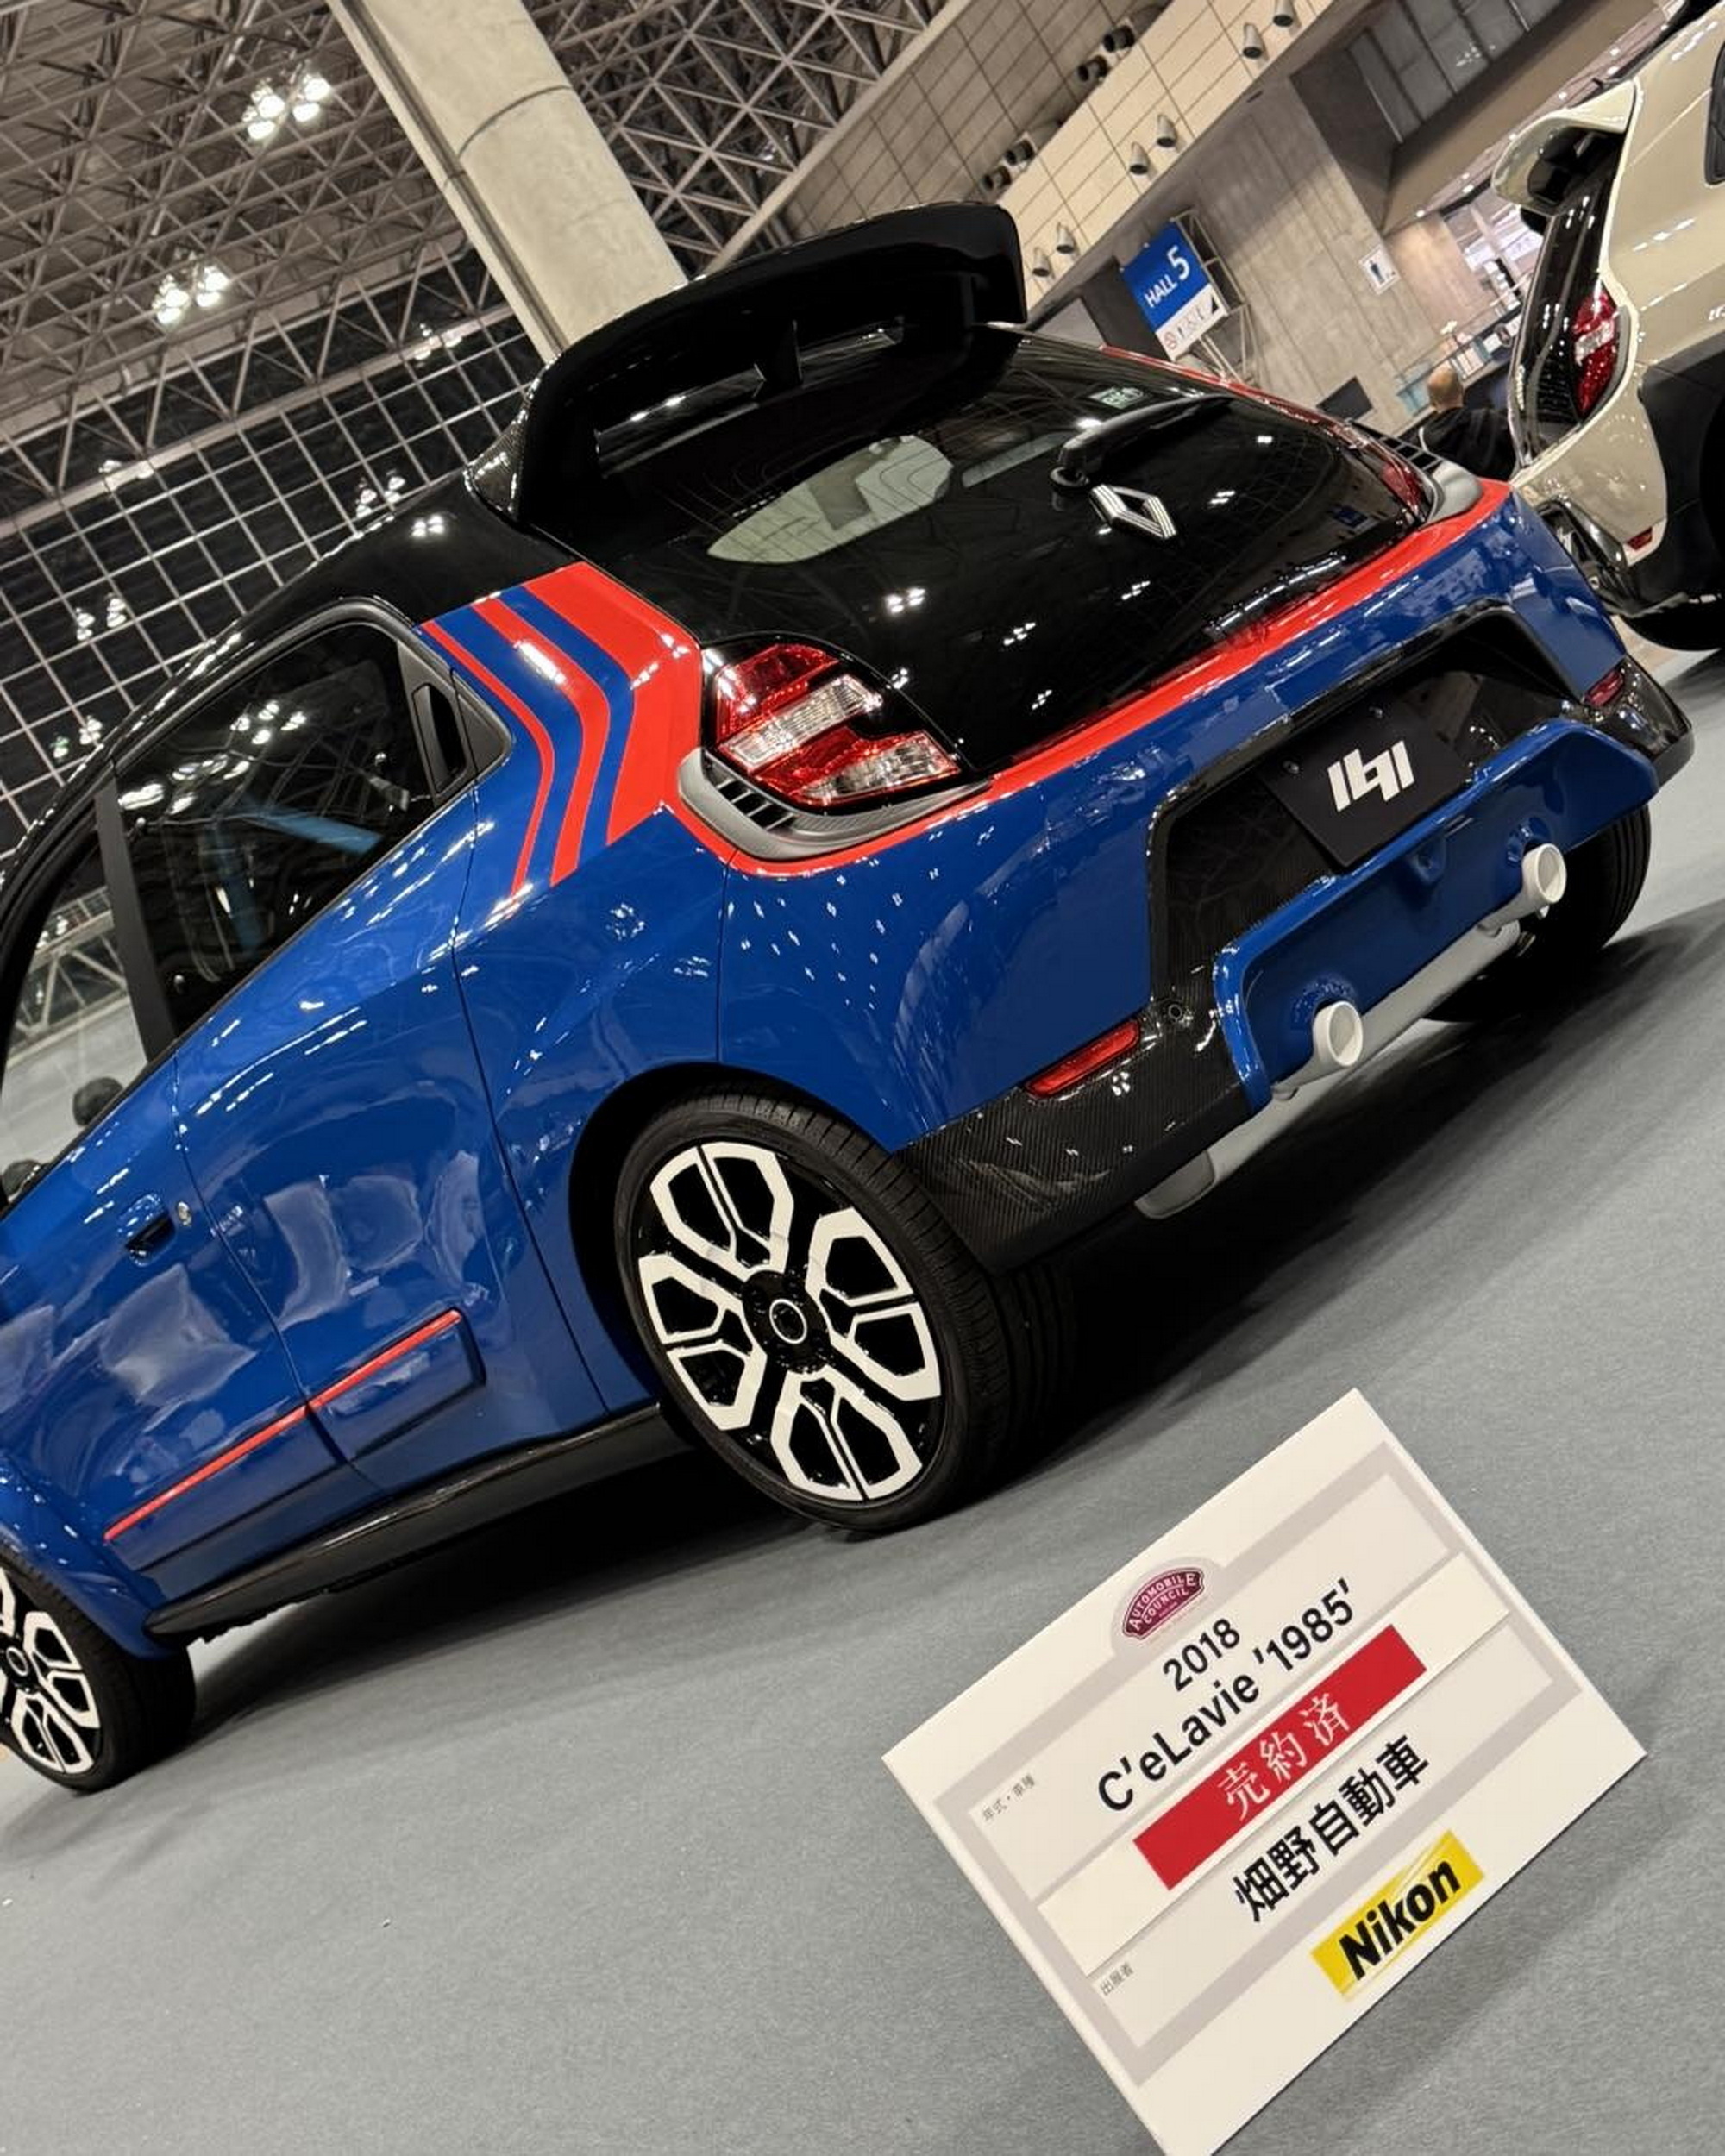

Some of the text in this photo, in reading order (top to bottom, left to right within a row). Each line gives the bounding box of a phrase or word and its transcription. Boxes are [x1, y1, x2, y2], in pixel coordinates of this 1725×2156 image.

[1144, 245, 1190, 308] HALL 5
[1129, 1572, 1196, 1631] AUTOMOBILE
[1143, 1587, 1189, 1624] COUNCIL
[1163, 1618, 1240, 1692] 2018
[1217, 1692, 1351, 1822] 売約済
[1233, 1734, 1430, 1923] 畑野自動車
[1339, 1860, 1462, 1981] Nikon
